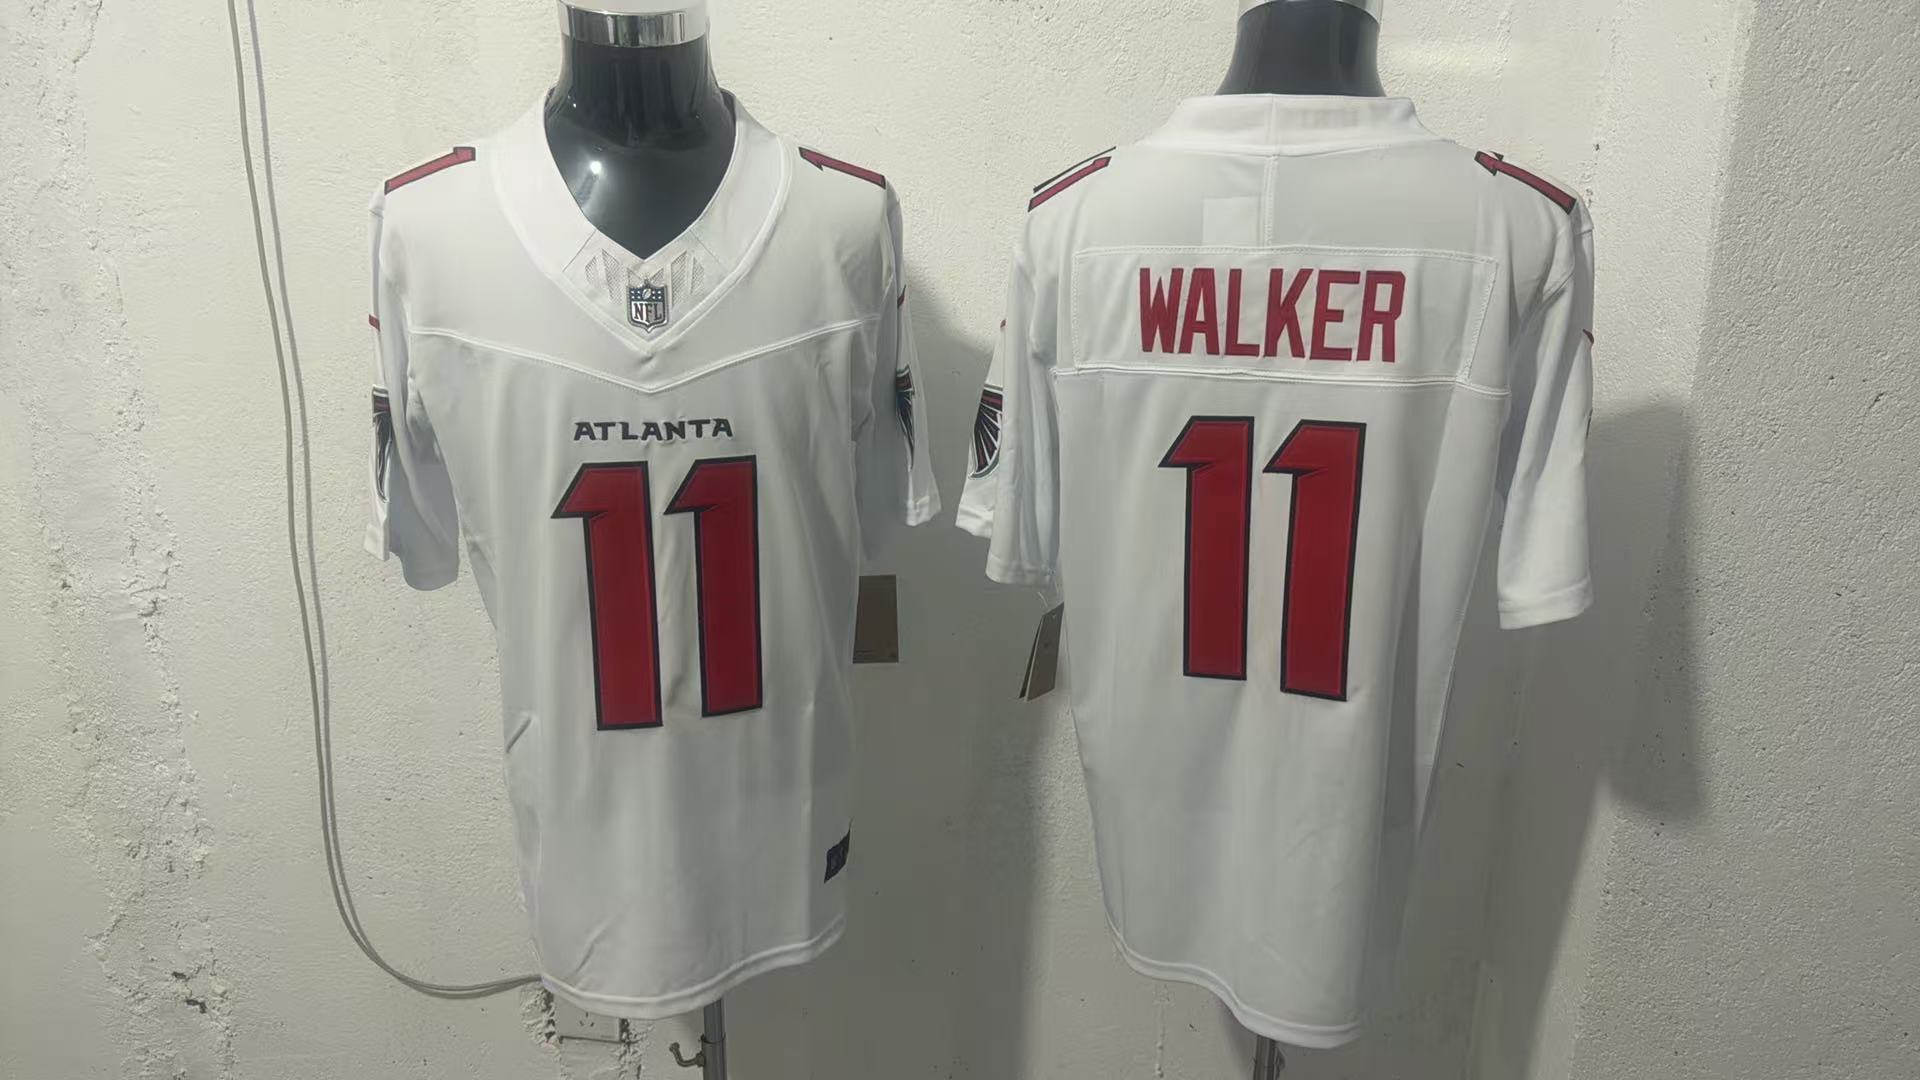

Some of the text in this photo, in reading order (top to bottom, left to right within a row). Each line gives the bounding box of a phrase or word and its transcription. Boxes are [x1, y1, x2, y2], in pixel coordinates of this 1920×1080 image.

[633, 302, 663, 322] NFL
[1139, 267, 1407, 363] WALKER
[573, 418, 733, 441] ATLANTA
[551, 454, 763, 731] 11
[1157, 415, 1367, 702] 11
